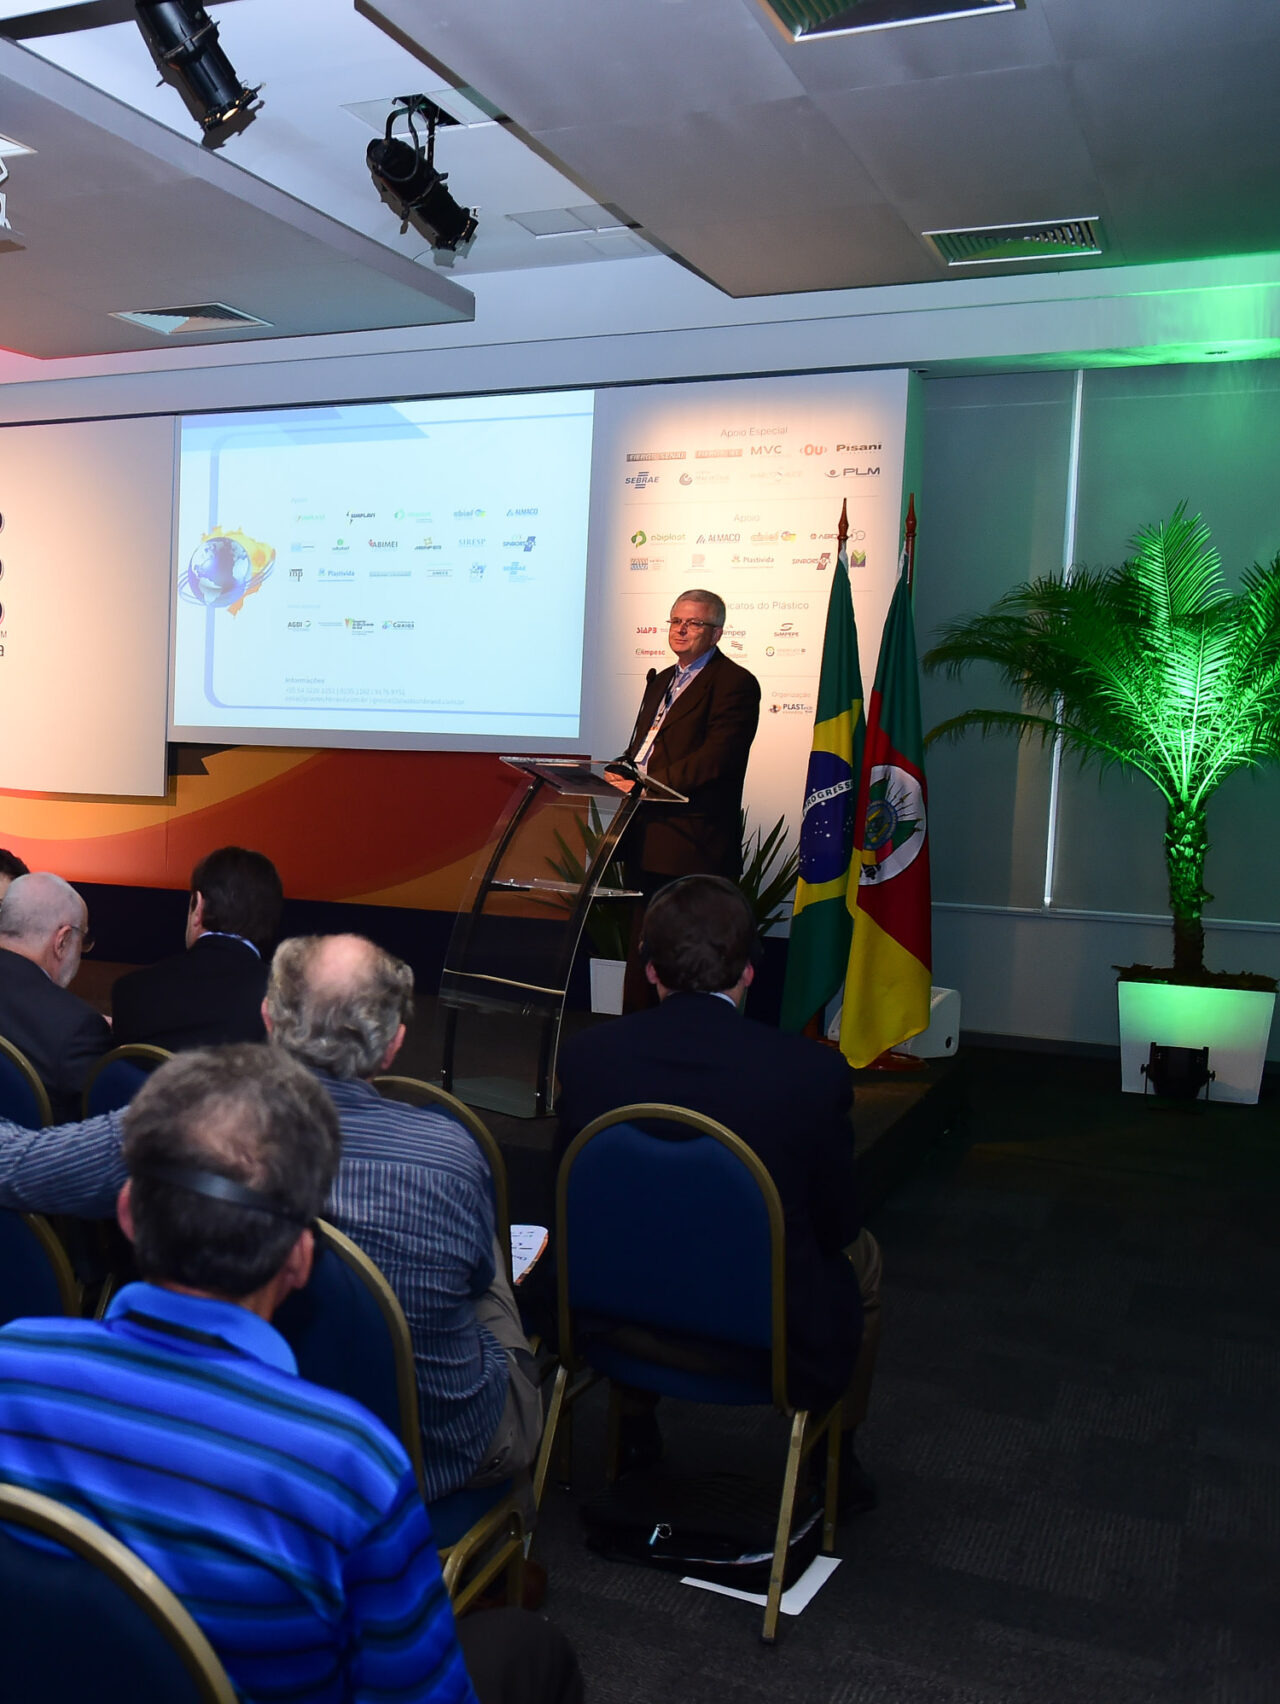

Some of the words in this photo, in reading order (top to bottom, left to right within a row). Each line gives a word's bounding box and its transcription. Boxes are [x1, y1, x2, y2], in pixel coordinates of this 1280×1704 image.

[720, 428, 747, 438] Apoio
[749, 426, 788, 437] Especial
[750, 445, 782, 455] MVC
[836, 443, 882, 452] Pisani
[842, 467, 880, 476] PLM
[625, 476, 659, 484] SEBRAE
[708, 533, 741, 542] ALMACO
[758, 601, 770, 610] do
[772, 600, 809, 610] Plástico
